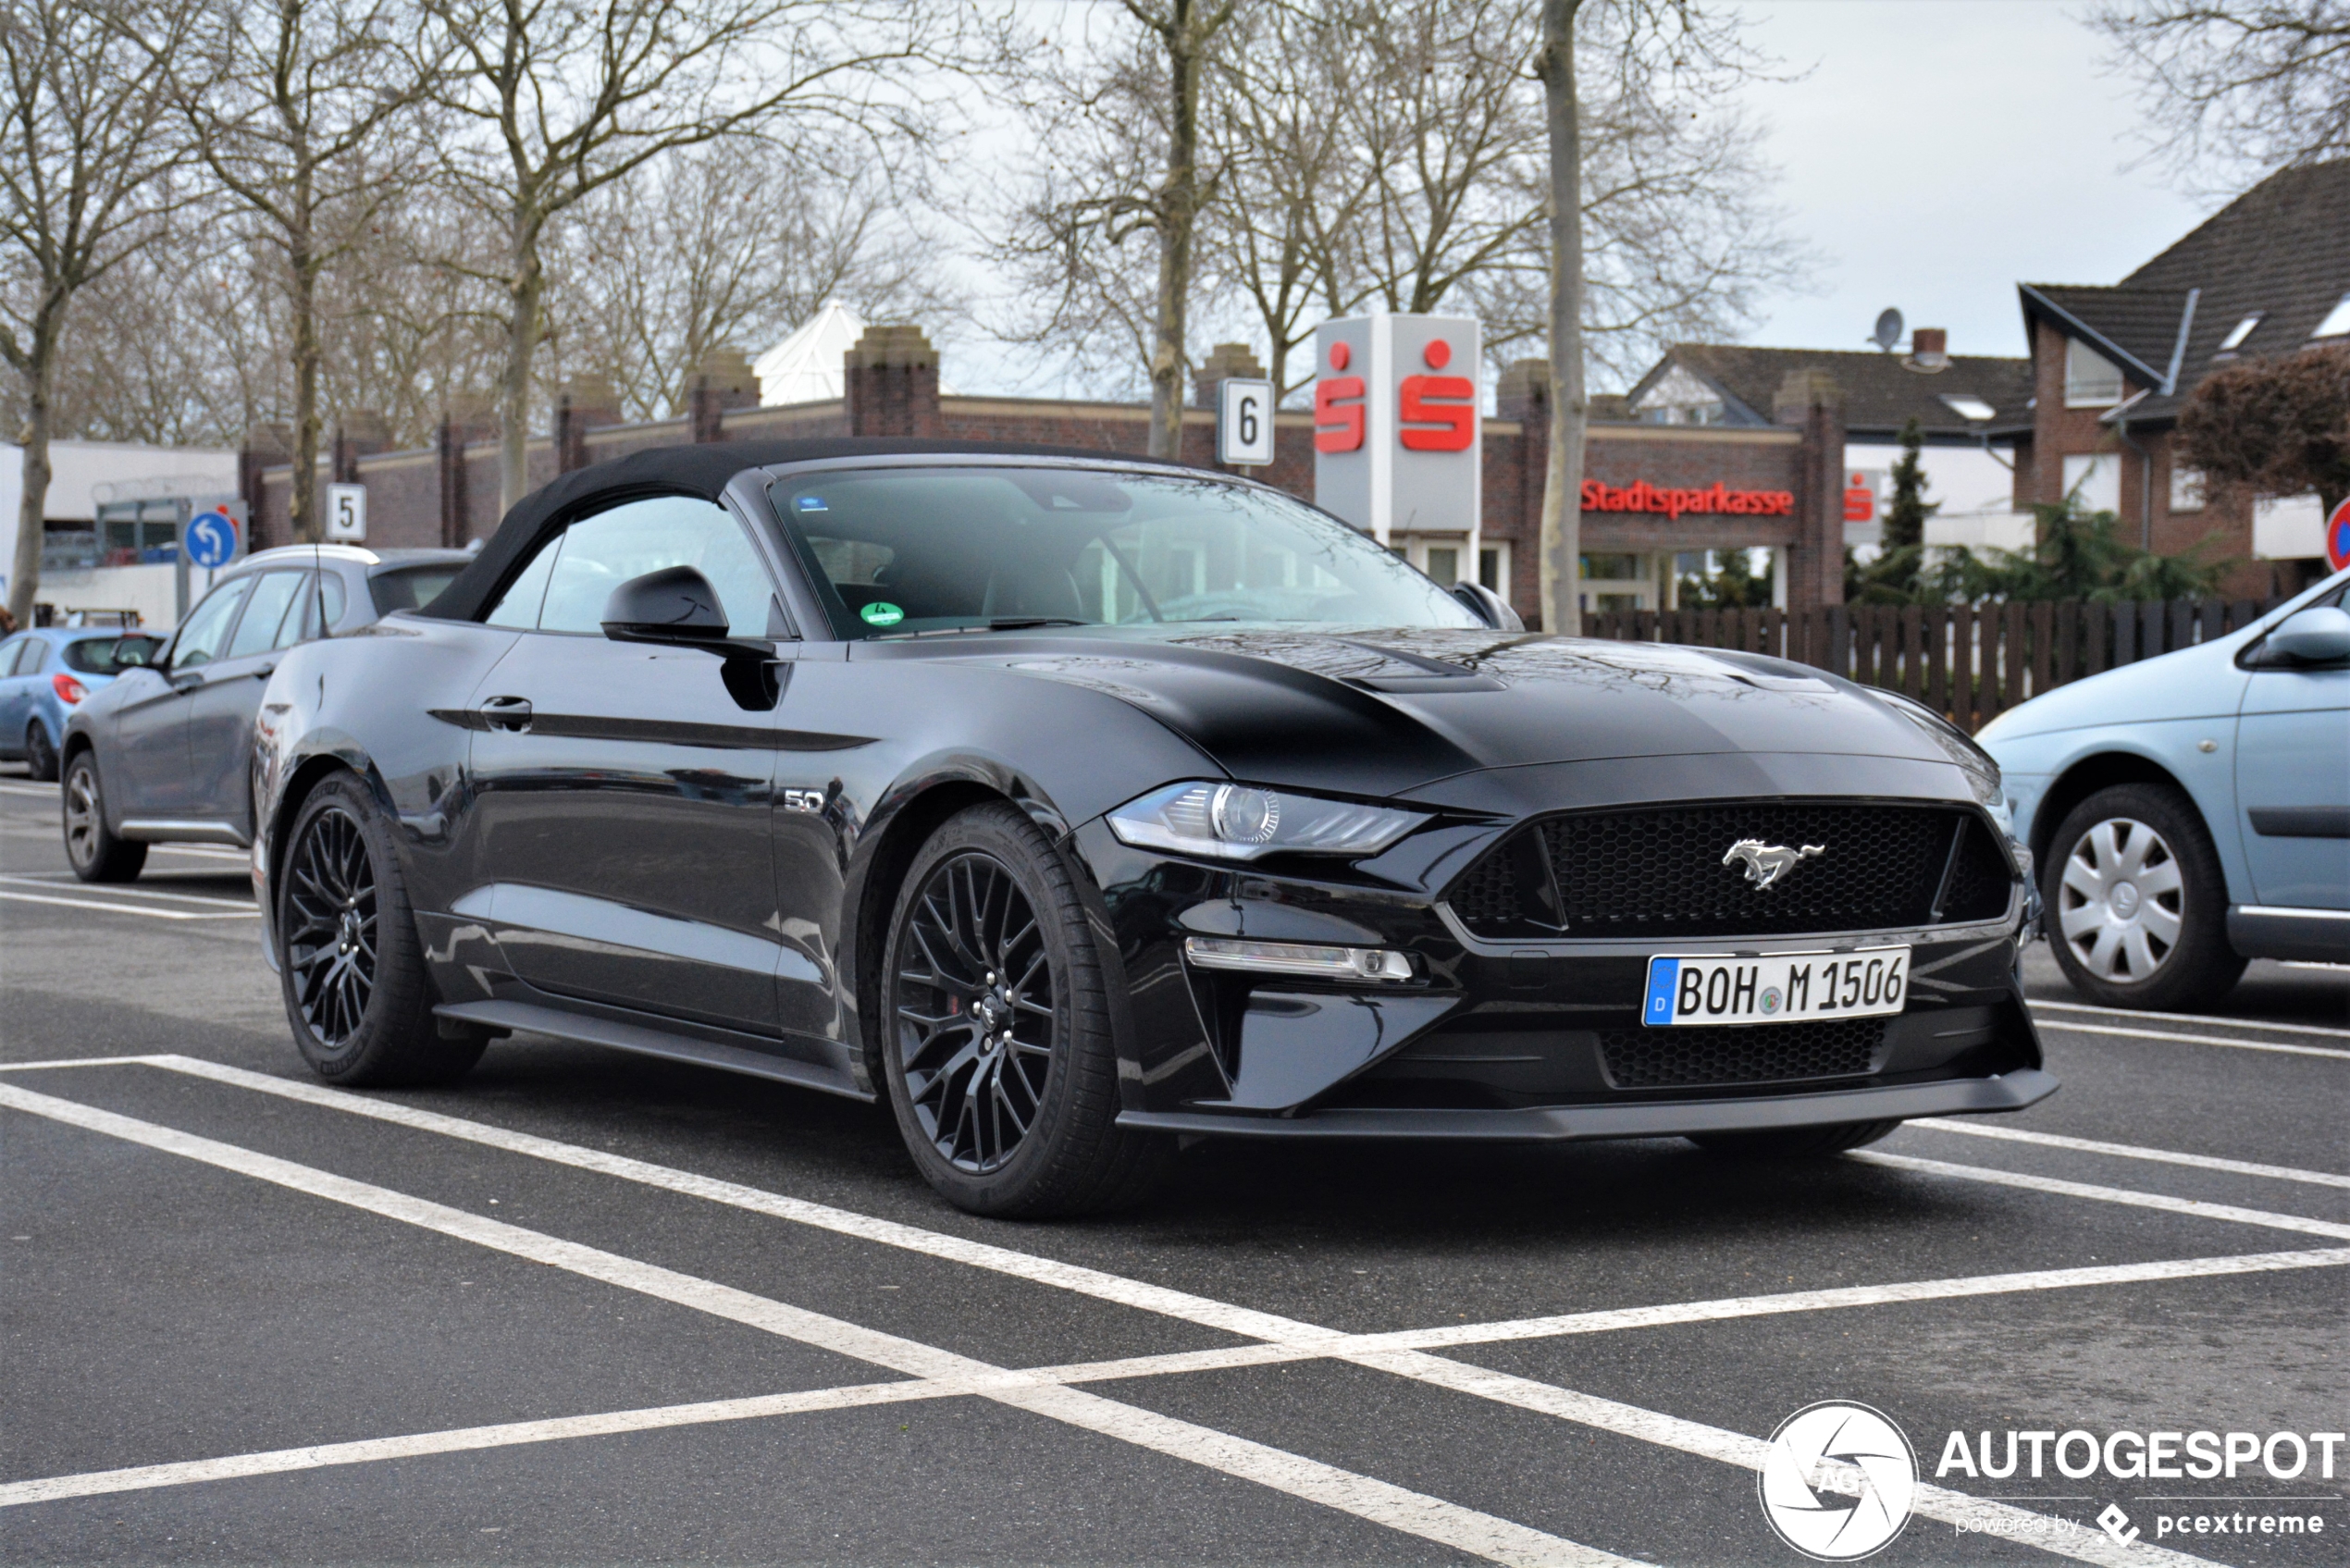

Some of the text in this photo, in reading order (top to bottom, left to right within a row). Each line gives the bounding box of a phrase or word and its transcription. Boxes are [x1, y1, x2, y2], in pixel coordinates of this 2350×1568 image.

[1240, 396, 1257, 446] 6
[340, 496, 353, 527] 5
[1581, 478, 1795, 520] Stadtsparkasse
[874, 603, 886, 613] 4
[1654, 997, 1665, 1012] D
[1677, 957, 1903, 1016] BOH M 1506
